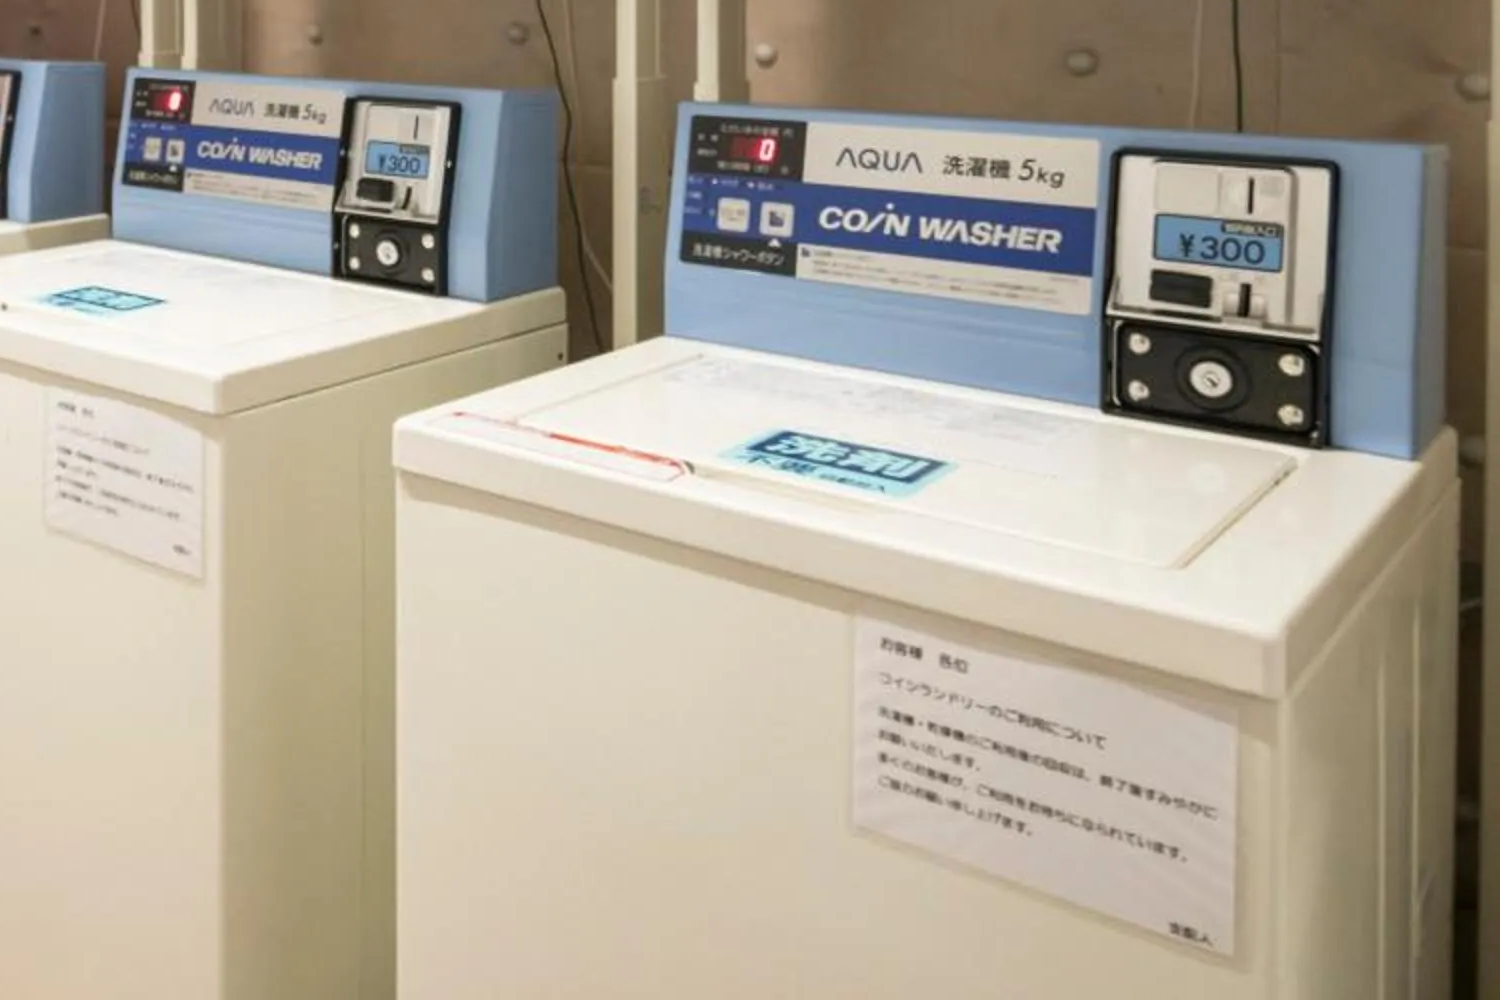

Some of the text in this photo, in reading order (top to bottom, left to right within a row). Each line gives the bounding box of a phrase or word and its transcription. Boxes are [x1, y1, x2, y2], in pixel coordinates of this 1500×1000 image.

[208, 98, 255, 116] AQUA
[196, 137, 323, 170] COIN WASHER
[759, 138, 776, 161] 0
[378, 154, 422, 174] ¥300
[835, 146, 1065, 189] AQUA 洗濯機 5kg
[818, 202, 1064, 255] COIN WASHER
[1179, 232, 1266, 265] ¥300
[880, 637, 922, 660] お客様
